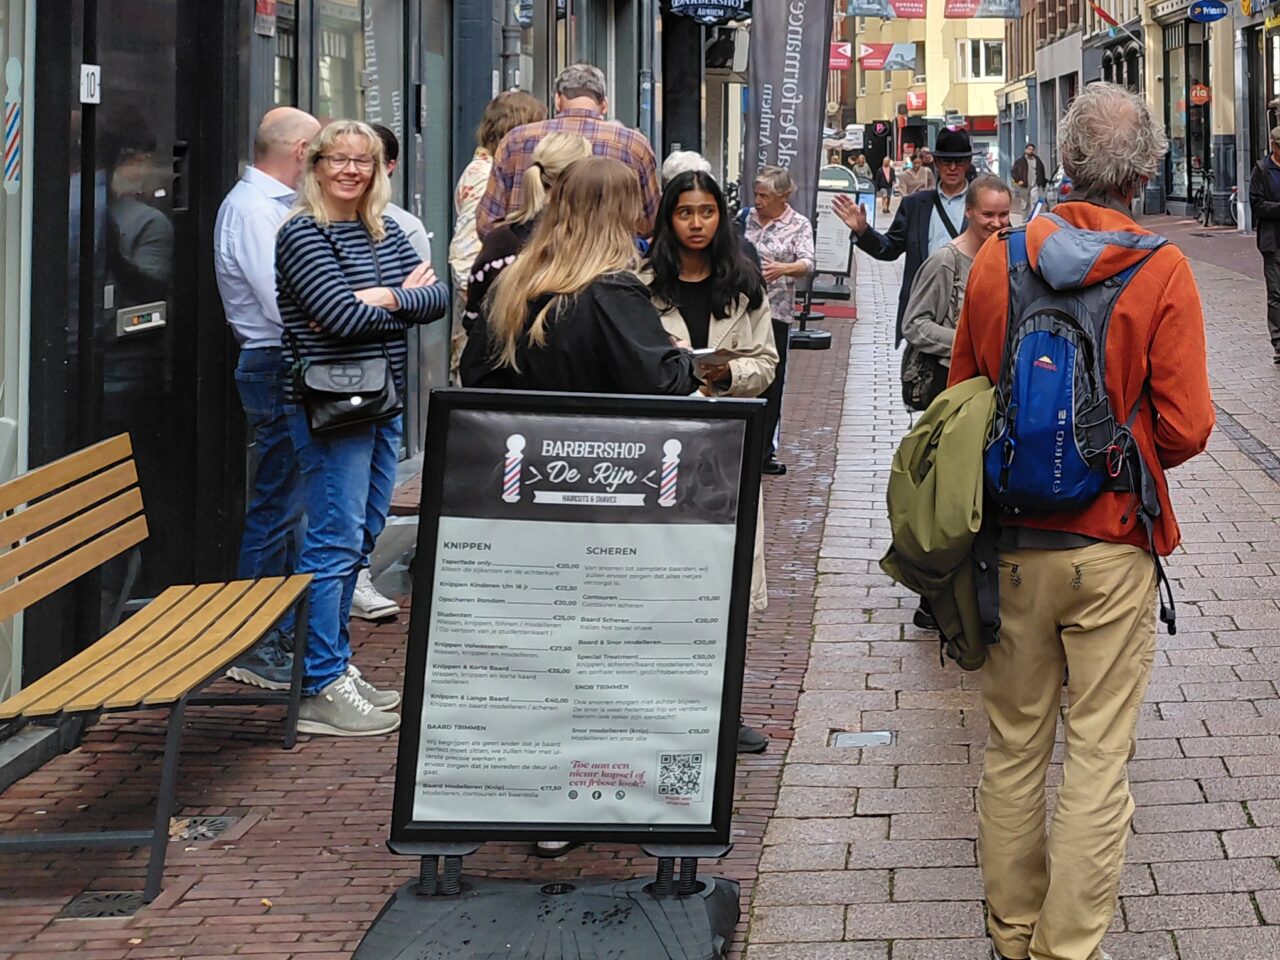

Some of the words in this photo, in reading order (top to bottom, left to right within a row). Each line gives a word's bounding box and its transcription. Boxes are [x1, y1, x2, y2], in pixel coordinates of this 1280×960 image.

[1203, 6, 1227, 15] Primera
[86, 71, 96, 98] 10
[541, 440, 646, 459] BARBERSHOP
[546, 460, 581, 483] De
[588, 462, 638, 492] Rijn
[443, 542, 492, 551] KNIPPEN
[586, 547, 637, 556] SCHEREN
